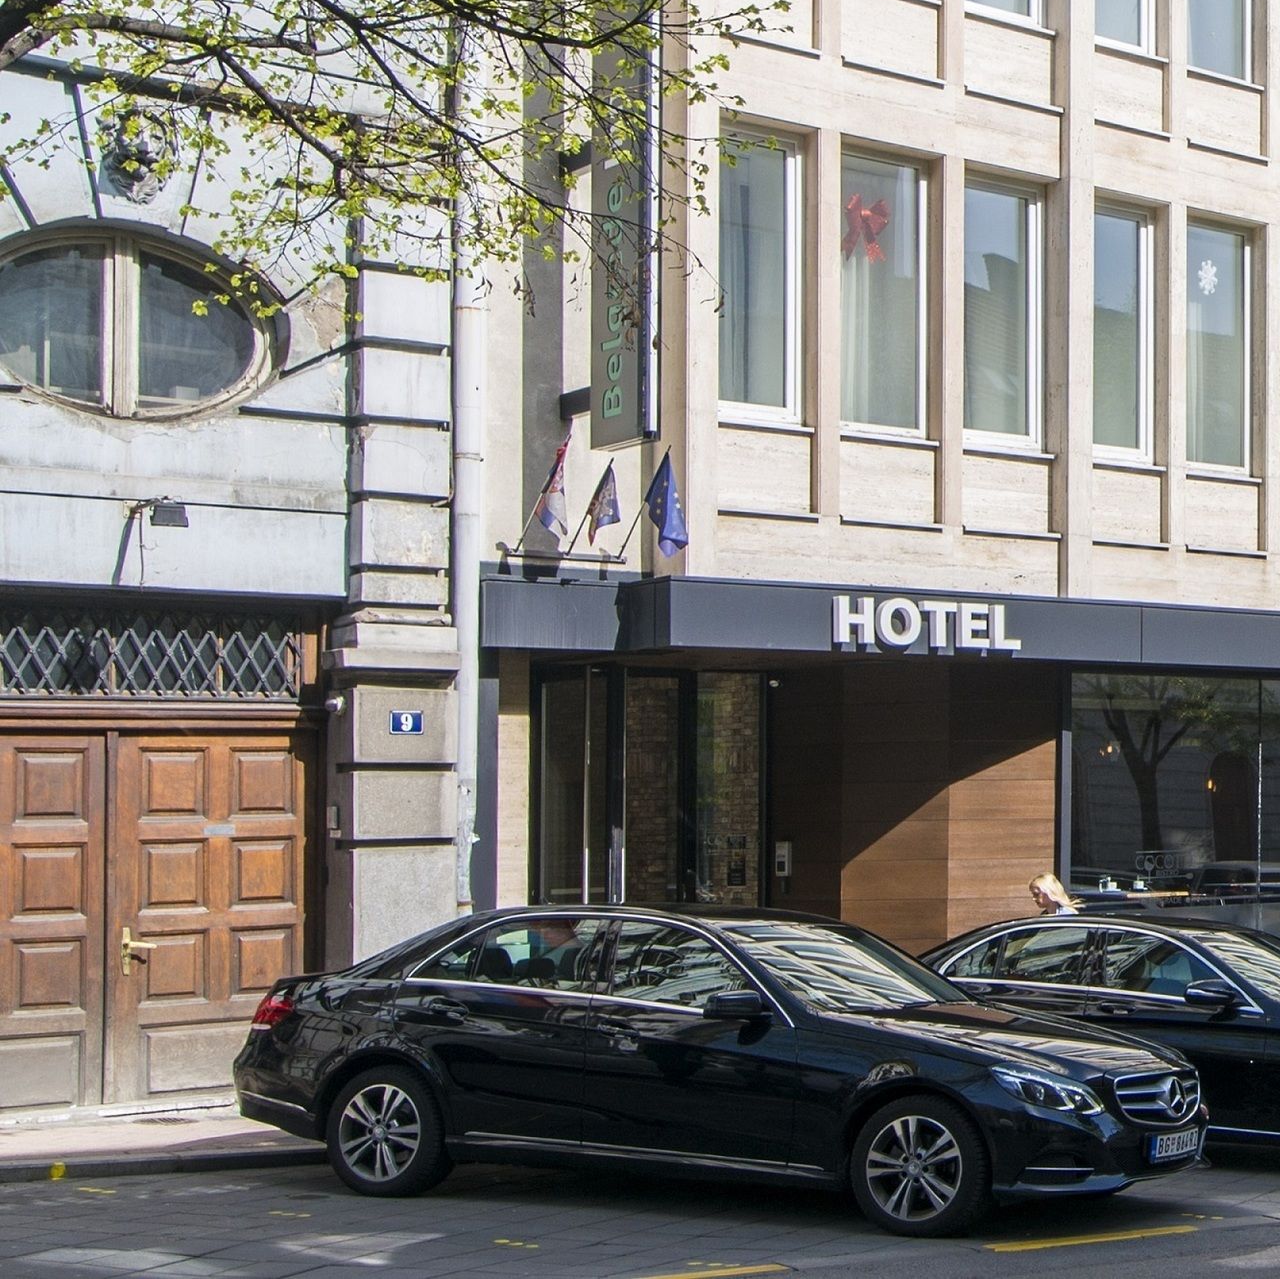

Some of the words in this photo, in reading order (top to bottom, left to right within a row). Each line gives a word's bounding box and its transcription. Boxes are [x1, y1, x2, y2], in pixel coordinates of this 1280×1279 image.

[833, 595, 1022, 650] HOTEL
[400, 713, 413, 732] 9
[1158, 1136, 1170, 1155] BG
